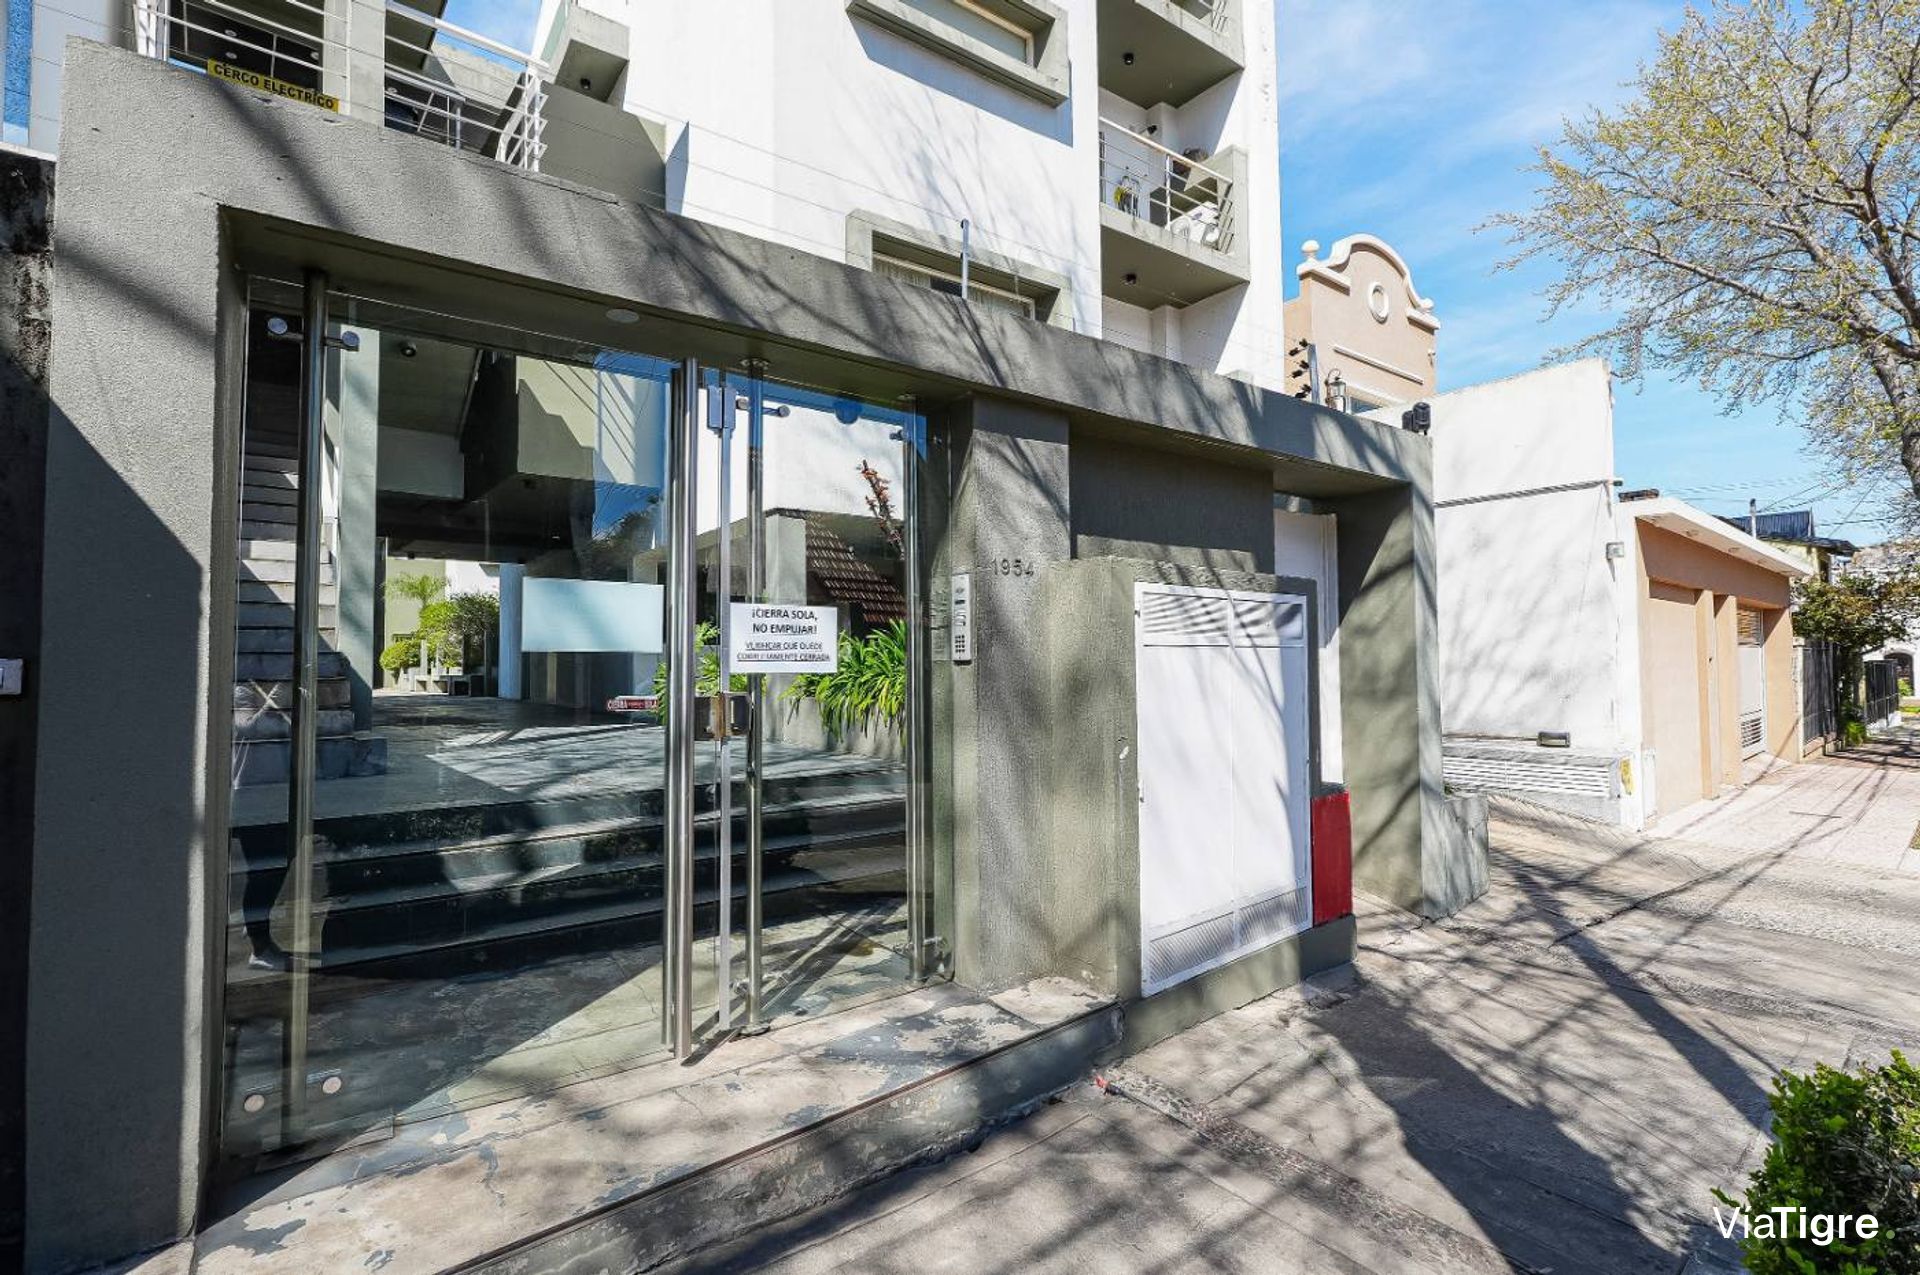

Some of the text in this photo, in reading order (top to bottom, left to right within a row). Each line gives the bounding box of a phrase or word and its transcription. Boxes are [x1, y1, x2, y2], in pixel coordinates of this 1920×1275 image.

[214, 63, 334, 109] CERCO ELECTRICO
[990, 558, 1034, 577] 1954
[752, 623, 817, 635] NO EMPUJAR!
